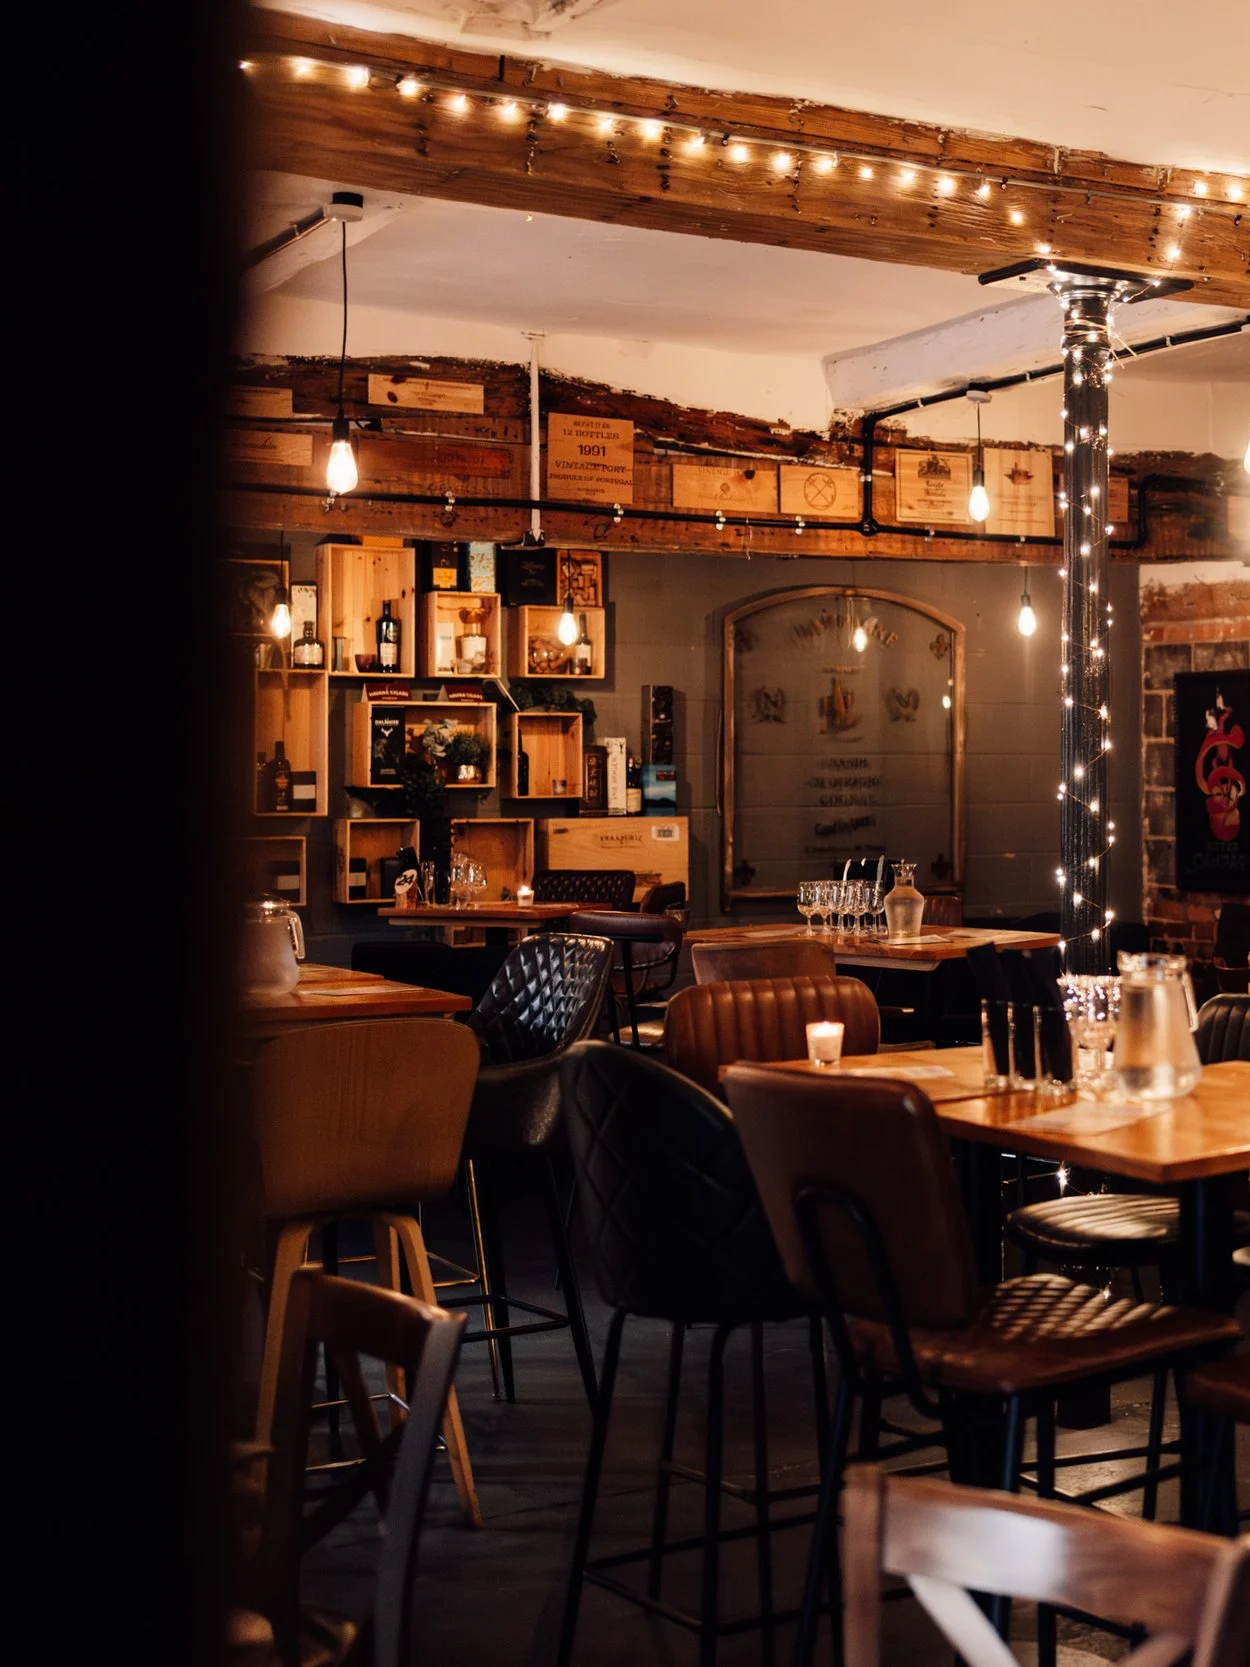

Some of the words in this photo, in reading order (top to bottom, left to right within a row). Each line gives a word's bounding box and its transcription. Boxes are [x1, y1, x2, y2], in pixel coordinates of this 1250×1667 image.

[578, 444, 606, 457] 1991
[602, 464, 626, 474] PORT
[596, 477, 633, 486] PORTUGAL
